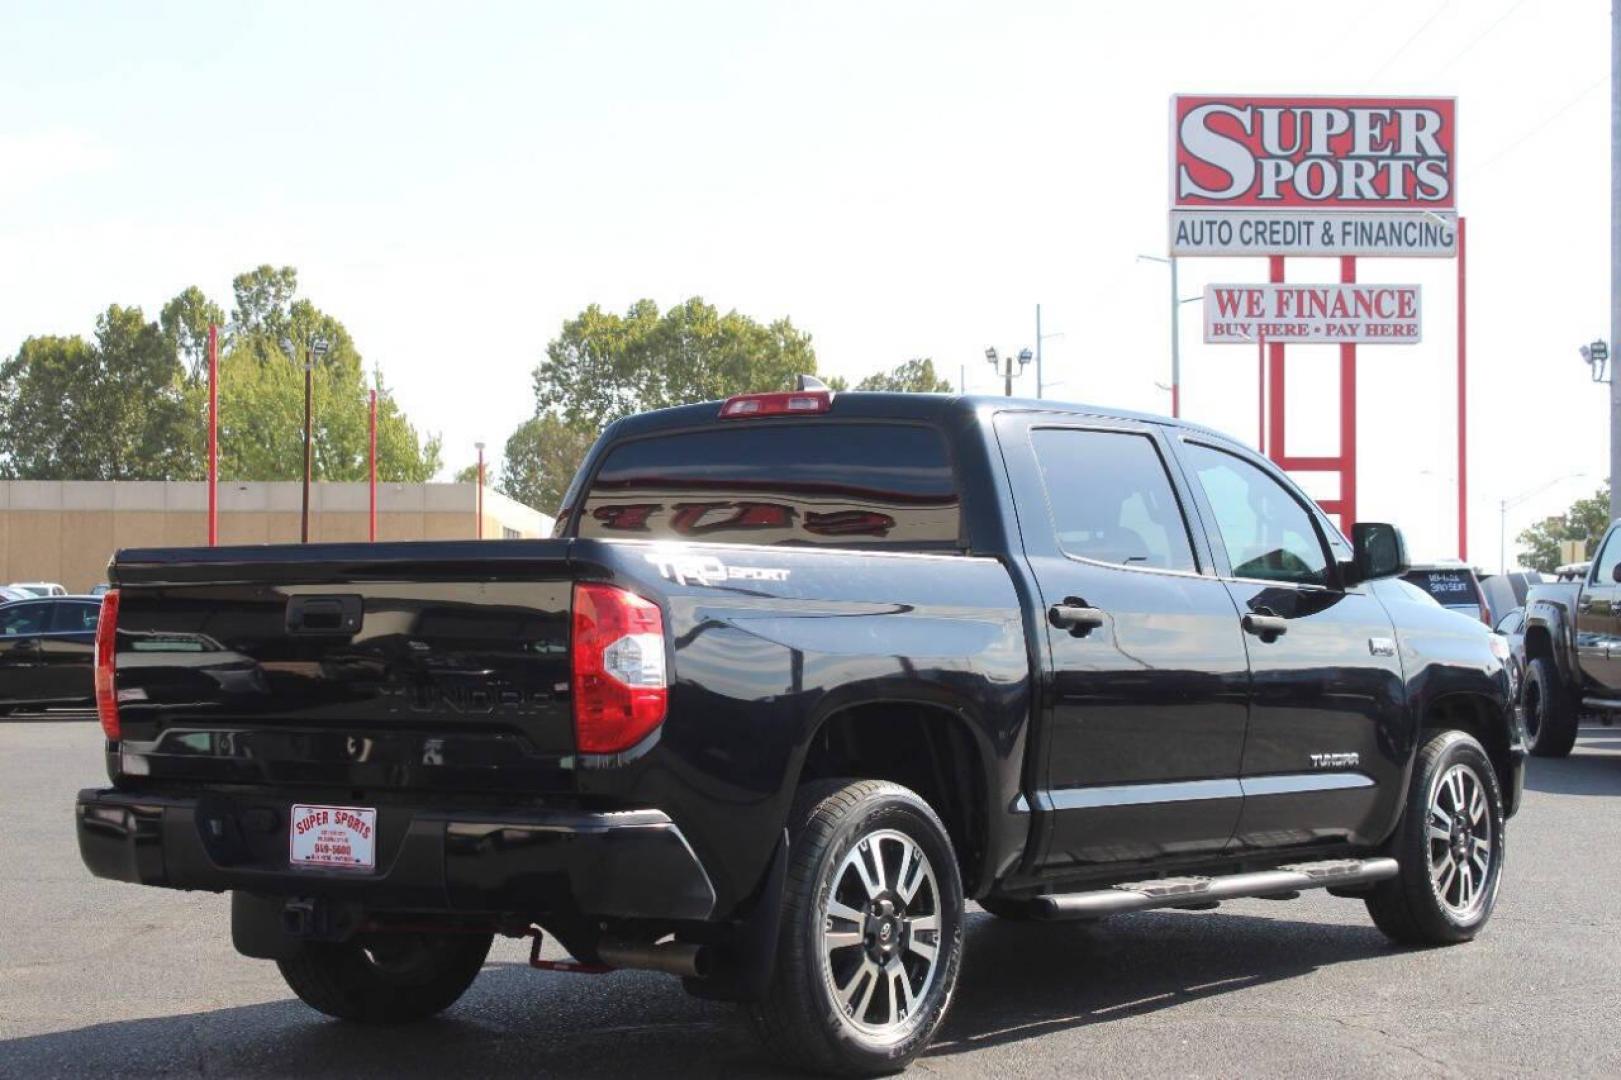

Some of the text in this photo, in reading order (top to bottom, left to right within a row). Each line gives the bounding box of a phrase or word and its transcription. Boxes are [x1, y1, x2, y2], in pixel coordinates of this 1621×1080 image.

[1180, 104, 1447, 200] SUPER
[1175, 220, 1454, 248] AUTO CREDIT & FINANCING
[1214, 289, 1417, 319] WE FINANCE
[1213, 323, 1418, 337] BUY HERE PAY HERE
[644, 553, 791, 587] TRD SPORT
[1310, 752, 1360, 767] TUNDRA
[296, 811, 371, 839] SUPER SPORTS
